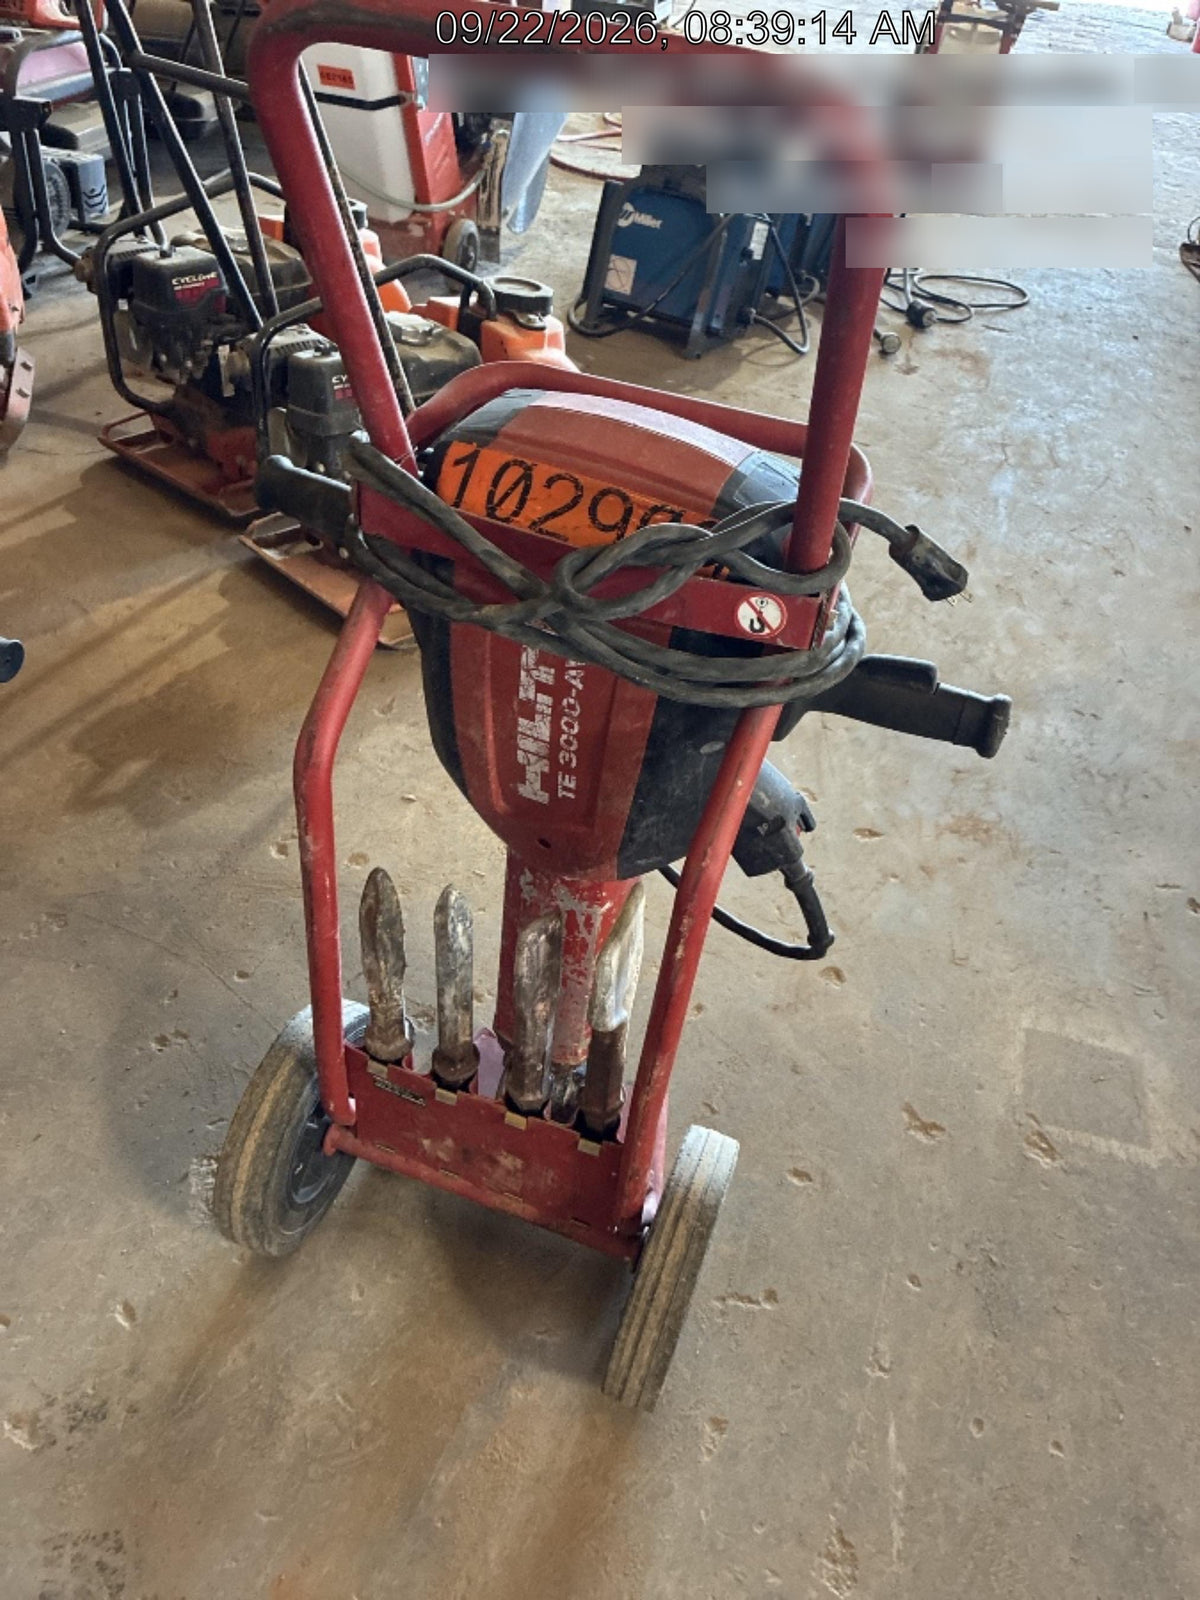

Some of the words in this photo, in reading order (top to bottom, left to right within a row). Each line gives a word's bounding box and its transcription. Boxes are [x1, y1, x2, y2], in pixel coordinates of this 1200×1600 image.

[451, 448, 718, 543] 1029
[516, 643, 556, 805] HILT
[557, 770, 578, 800] TE
